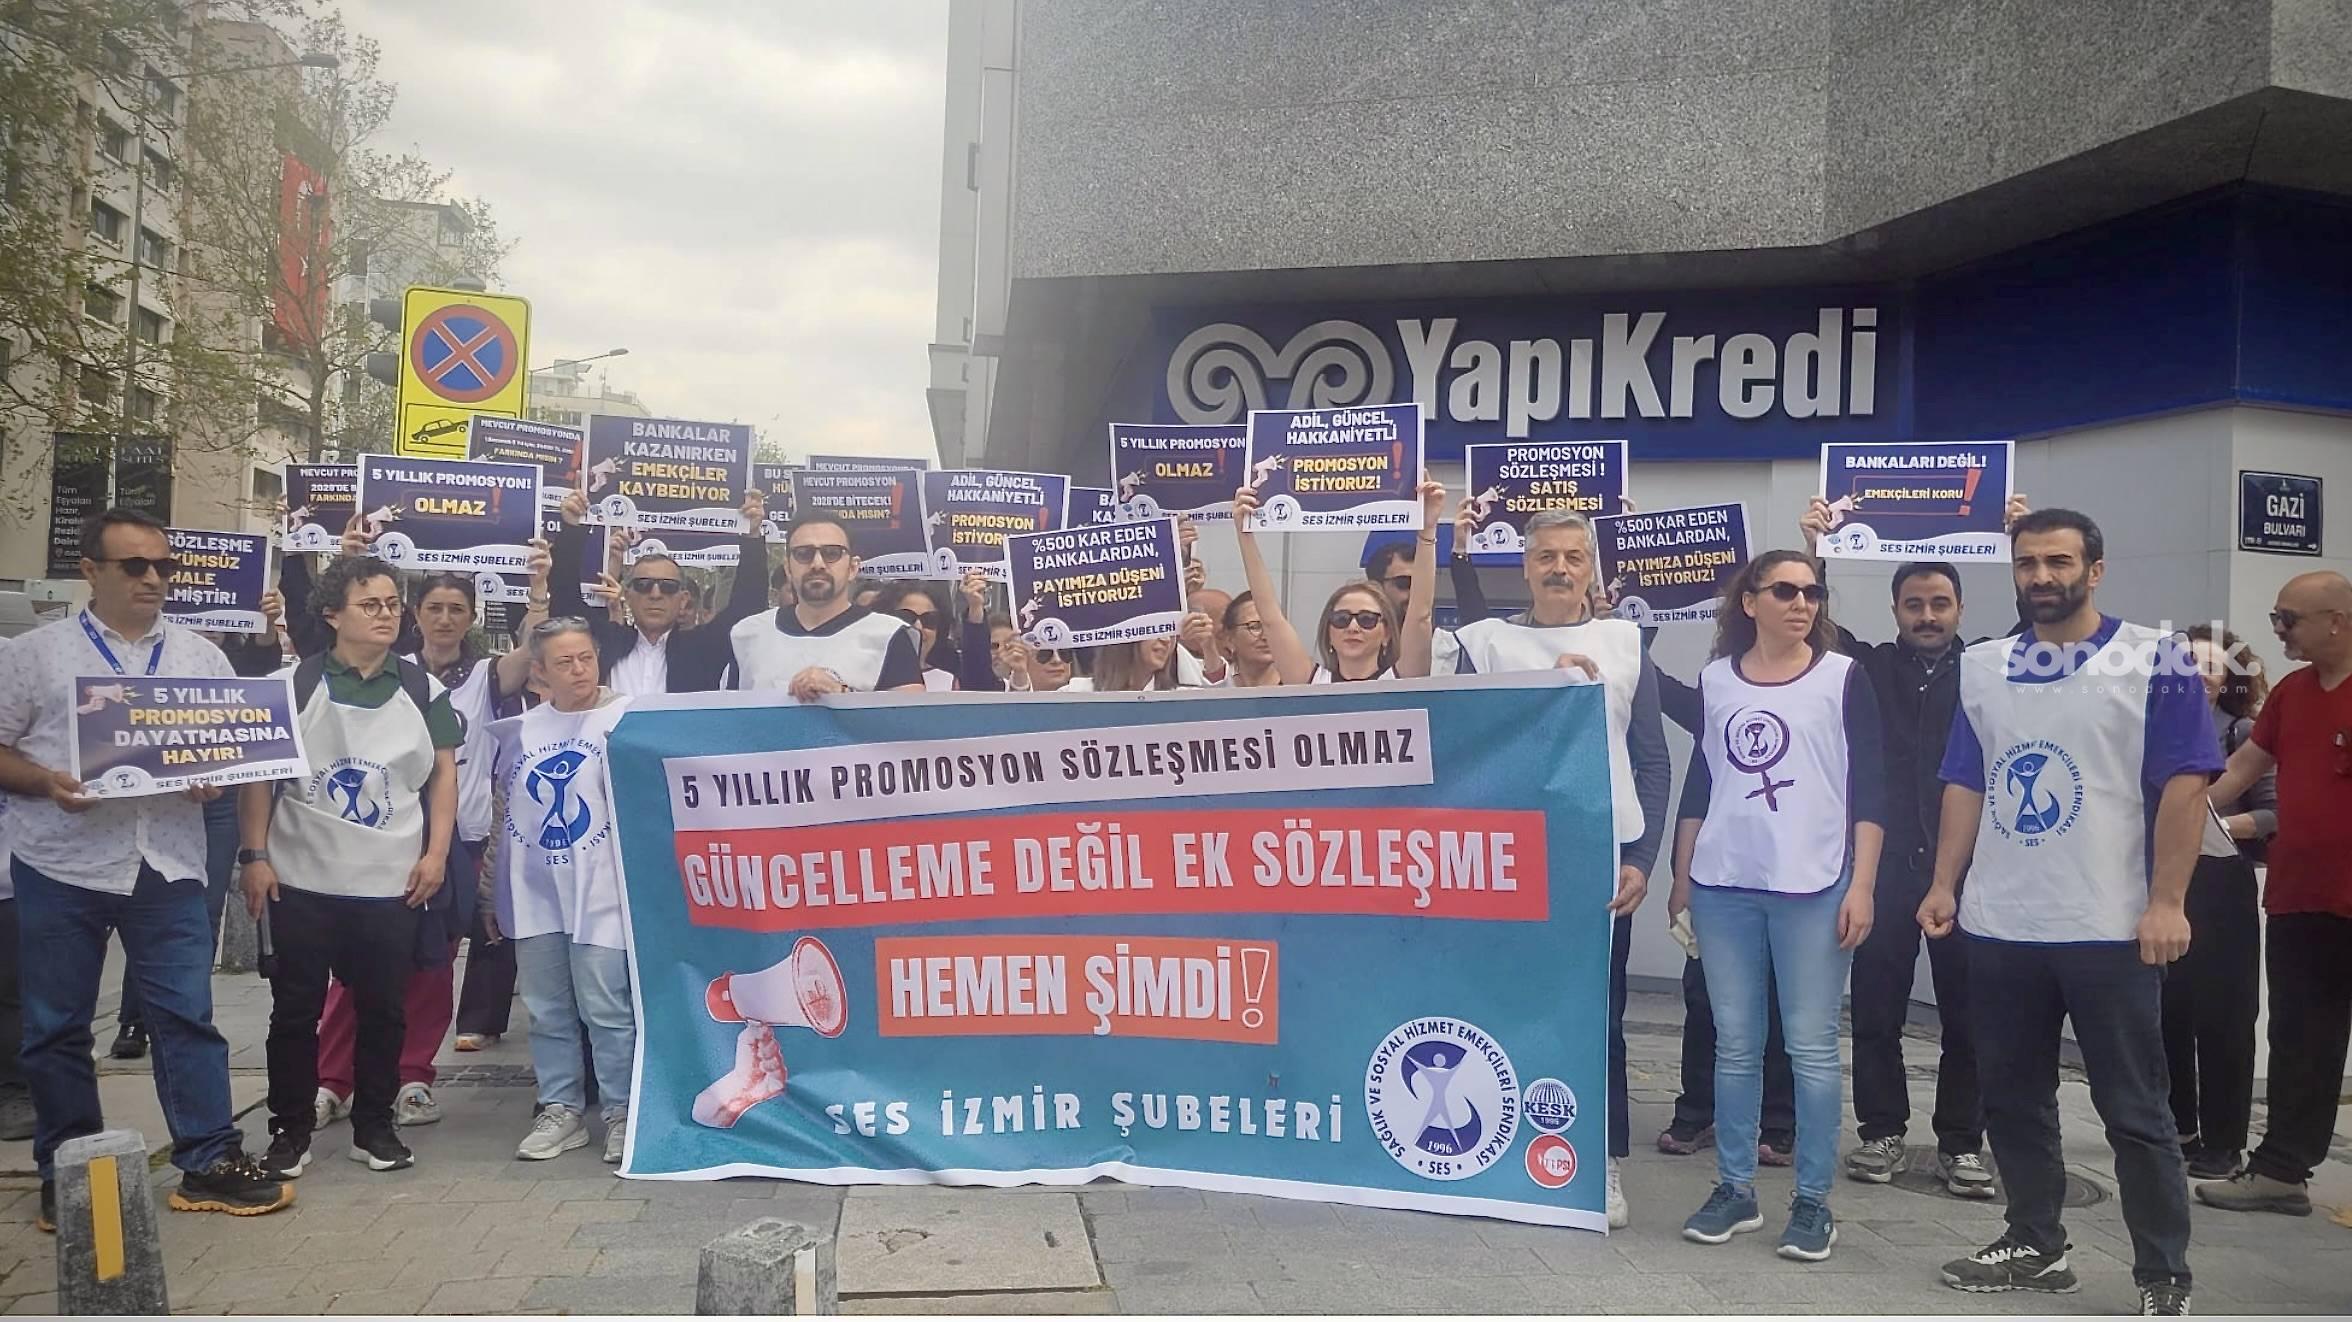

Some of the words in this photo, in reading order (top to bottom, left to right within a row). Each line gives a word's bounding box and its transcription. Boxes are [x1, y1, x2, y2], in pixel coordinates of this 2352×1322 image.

[1290, 413, 1328, 430] ADİL,
[1332, 410, 1393, 427] GÜNCEL,
[632, 422, 730, 444] BANKALAR
[1287, 424, 1397, 445] HAKKANİYETLİ
[624, 442, 737, 462] KAZANIRKEN
[1120, 438, 1128, 448] 5
[1130, 438, 1168, 449] YILLIK
[1508, 446, 1604, 462] PROMOSYON
[1846, 456, 1935, 468] BANKALARI
[1938, 452, 1987, 468] DEĞİL!
[632, 462, 728, 482] EMEKÇİLER
[1155, 462, 1214, 478] OLMAZ
[1293, 456, 1388, 472] PROMOSYON
[1500, 460, 1596, 480] SÖZLEŞMESİ
[372, 468, 382, 480] 5
[386, 470, 434, 484] YILLIK
[436, 472, 532, 490] PROMOSYON!
[950, 473, 982, 488] ADİL,
[986, 474, 1042, 491] GÜNCEL,
[1295, 476, 1380, 492] İSTİYORUZ!
[1530, 480, 1578, 496] SATIŞ
[619, 480, 730, 502] KAYBEDİYOR
[947, 488, 1045, 506] HAKKANİYETLİ
[1864, 488, 1930, 501] EMEKÇİLERİ
[414, 497, 486, 516] OLMAZ
[2266, 492, 2304, 520] GAZİ
[637, 514, 658, 524] SES
[660, 514, 687, 526] İZMİR
[688, 515, 738, 528] ŞUBELERİ
[952, 514, 1034, 530] PROMOSYON
[1302, 516, 1323, 526] SES
[1325, 515, 1354, 526] İZMİR
[1356, 514, 1410, 527] ŞUBELERİ
[1614, 518, 1653, 534] %500
[1656, 514, 1686, 530] KAR
[1688, 510, 1728, 526] EDEN
[2264, 522, 2306, 537] BULVARI
[952, 529, 1007, 545] İSTİYOR
[1032, 536, 1075, 554] %500
[1078, 530, 1111, 548] KAR
[1114, 526, 1157, 544] EDEN
[1617, 527, 1730, 551] BANKALARDAN,
[417, 553, 438, 562] SES
[440, 553, 470, 564] İZMİR
[1032, 543, 1159, 570] BANKALARDAN,
[1880, 544, 1904, 553] SES
[1904, 543, 1936, 554] İZMİR
[1938, 543, 1996, 556] ŞUBELERİ
[1616, 555, 1682, 574] PAYIMIZA
[1685, 548, 1736, 568] DÜŞENİ
[1032, 573, 1107, 594] PAYIMIZA
[1110, 563, 1164, 586] DÜŞENİ
[1639, 568, 1716, 587] İSTİYORUZ!
[1058, 586, 1143, 608] İSTİYORUZ!
[174, 614, 202, 624] İZMİR
[204, 617, 254, 629] ŞUBELERİ
[1652, 613, 1671, 622] SES
[1672, 610, 1698, 620] İZMİR
[1072, 633, 1094, 643] SES
[1095, 628, 1122, 640] İZMİR
[1124, 621, 1176, 638] ŞUBELERİ
[153, 688, 168, 704] 5
[172, 688, 246, 704] YILLIK
[129, 708, 272, 726] PROMOSYON
[114, 726, 290, 747] DAYATMASINA
[162, 746, 244, 766] HAYIR!
[156, 779, 184, 789] SES
[226, 766, 293, 782] ŞUBELERİ
[682, 775, 699, 809] 5
[712, 768, 814, 808] YILLIK
[831, 751, 1044, 800] PROMOSYON
[1060, 728, 1277, 786] SÖZLEŞMESİ
[1293, 728, 1416, 768] OLMAZ
[2025, 838, 2040, 847] SES
[546, 854, 569, 865] SES
[684, 843, 995, 912] GÜNCELLEME
[1014, 822, 1154, 894] DEĞİL
[1172, 832, 1234, 889] EK
[1252, 818, 1518, 908] SÖZLEŞME
[890, 955, 1068, 1018] HEMEN
[1404, 1021, 1454, 1040] HİZMET
[1370, 1036, 1404, 1083] SOSYAL
[1458, 1026, 1516, 1092] EMEKÇİLERİ
[1369, 1088, 1381, 1105] VE
[825, 1101, 910, 1138] SES
[940, 1085, 1087, 1136] İZMİR
[1112, 1092, 1342, 1143] ŞUBELERİ
[1524, 1102, 1576, 1118] KESK
[1372, 1110, 1406, 1158] SAĞLIK
[1476, 1096, 1515, 1166] SENDİKASI
[1428, 1140, 1452, 1154] 1996
[1428, 1161, 1451, 1175] SES
